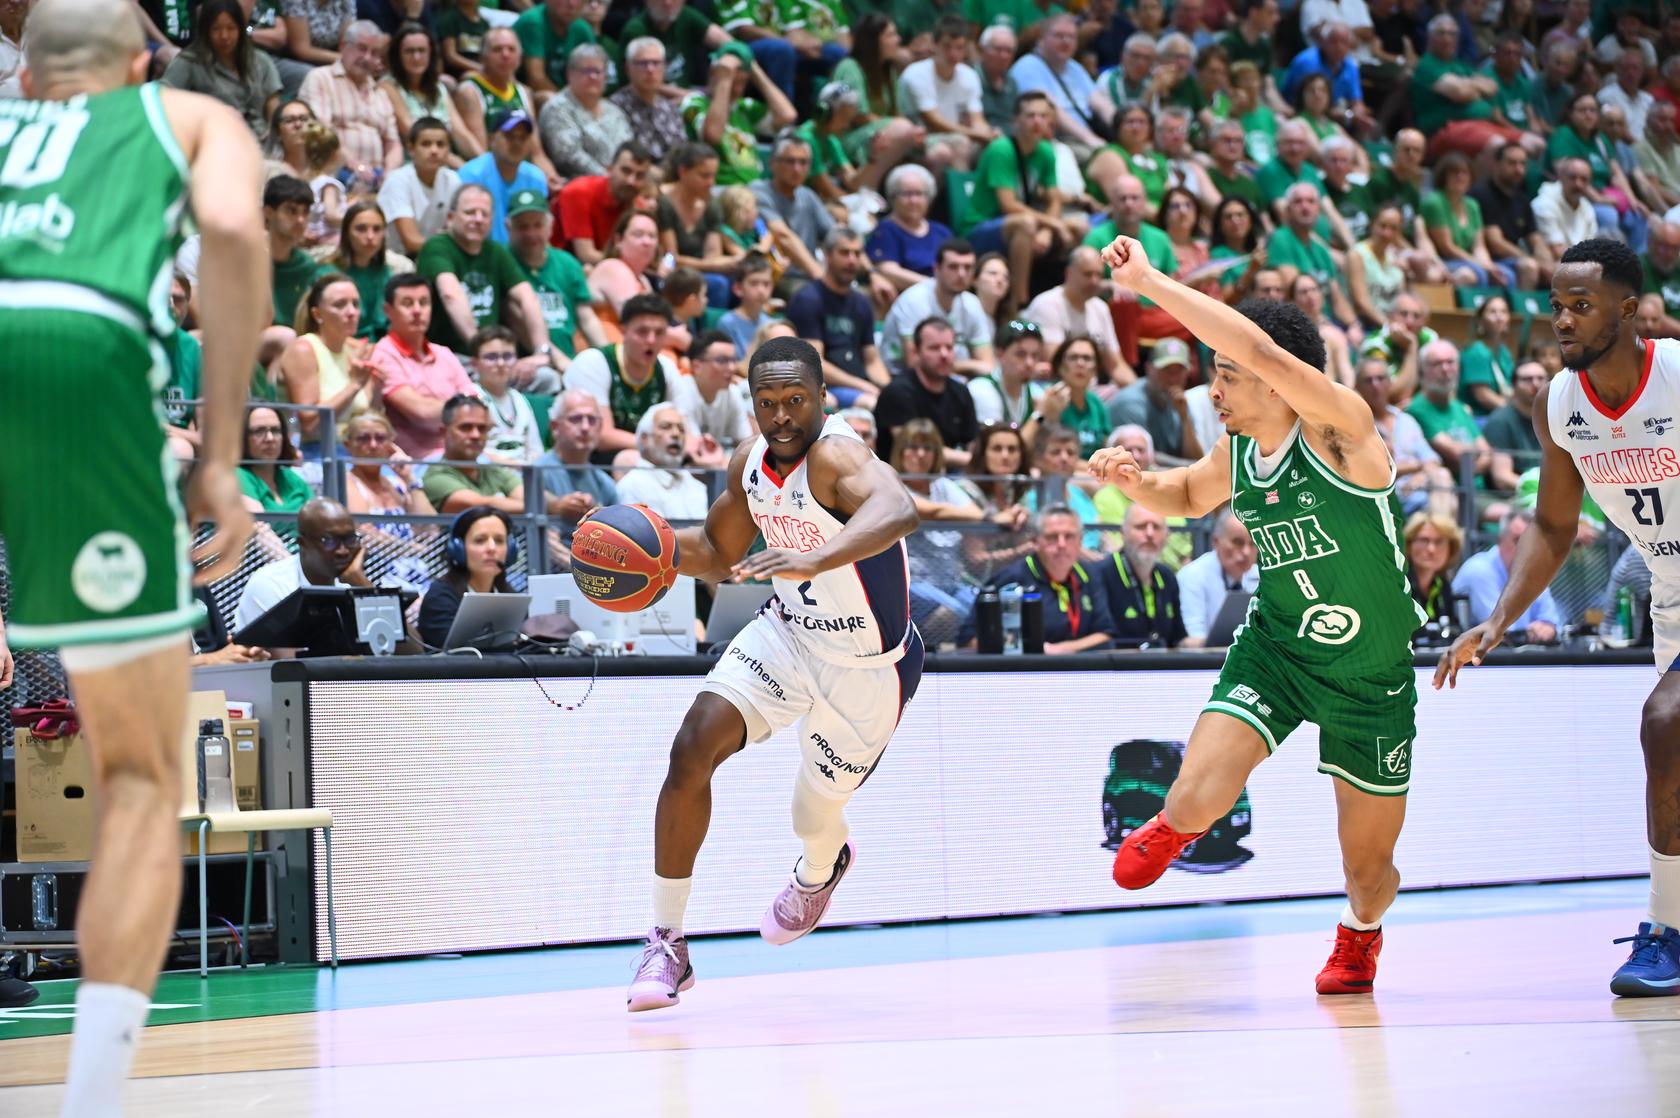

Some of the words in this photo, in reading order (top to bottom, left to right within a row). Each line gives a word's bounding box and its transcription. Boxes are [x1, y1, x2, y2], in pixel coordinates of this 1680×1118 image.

[1580, 447, 1680, 484] NANTES
[1250, 515, 1340, 570] ADA
[1293, 569, 1319, 600] 8
